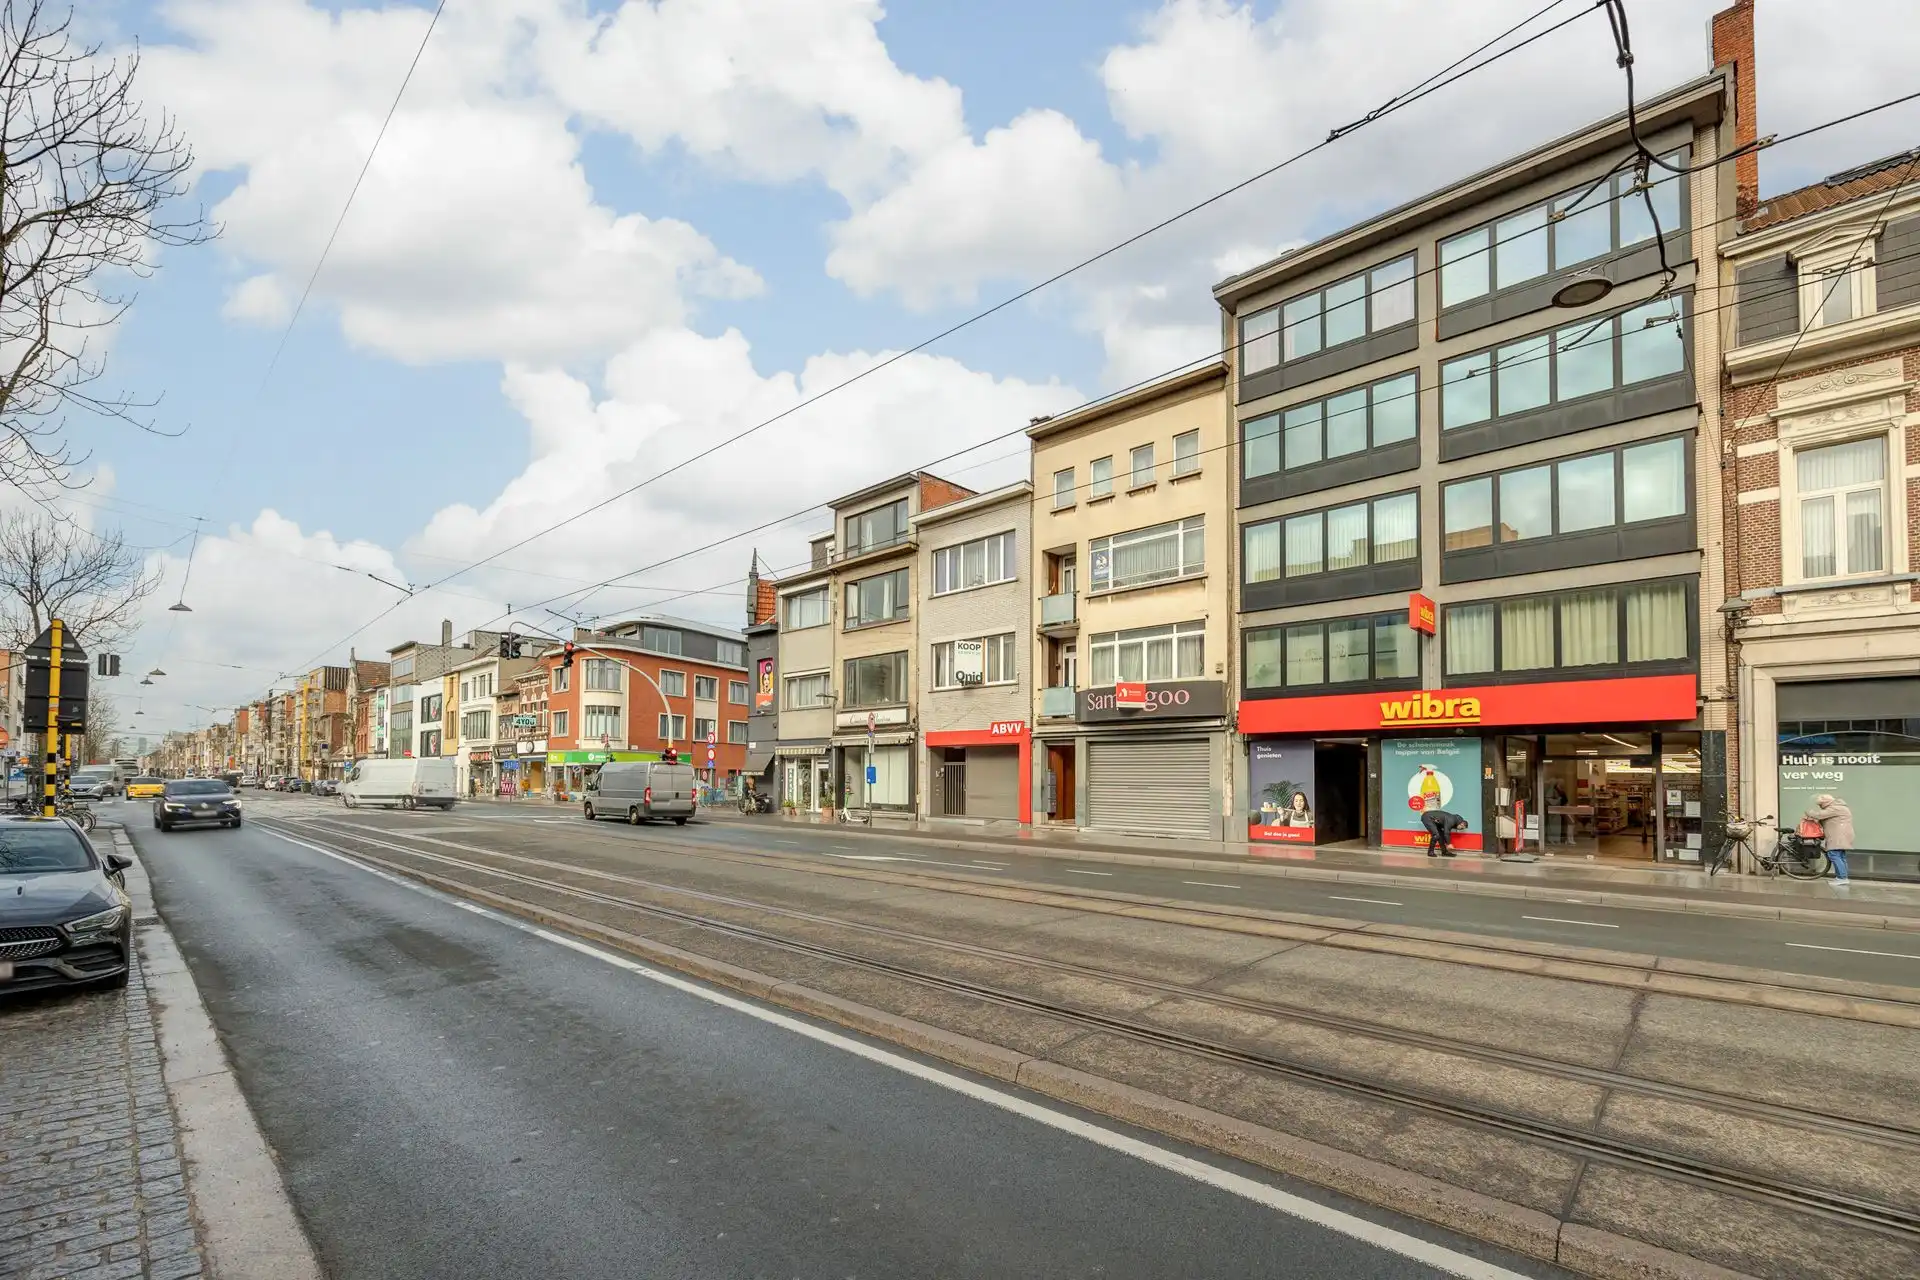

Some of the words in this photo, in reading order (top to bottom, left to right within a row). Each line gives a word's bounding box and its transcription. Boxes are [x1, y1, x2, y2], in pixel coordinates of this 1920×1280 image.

[1420, 605, 1434, 623] wibra
[957, 642, 982, 651] KOOP
[1087, 690, 1190, 712] Samgoo
[1380, 692, 1481, 719] wibra
[991, 723, 1022, 735] ABVV
[1256, 752, 1282, 760] genieten
[1782, 754, 1818, 767] Hulp
[1821, 753, 1835, 765] is
[1838, 753, 1881, 765] nooit
[1783, 771, 1809, 780] ver
[1811, 771, 1844, 782] weg
